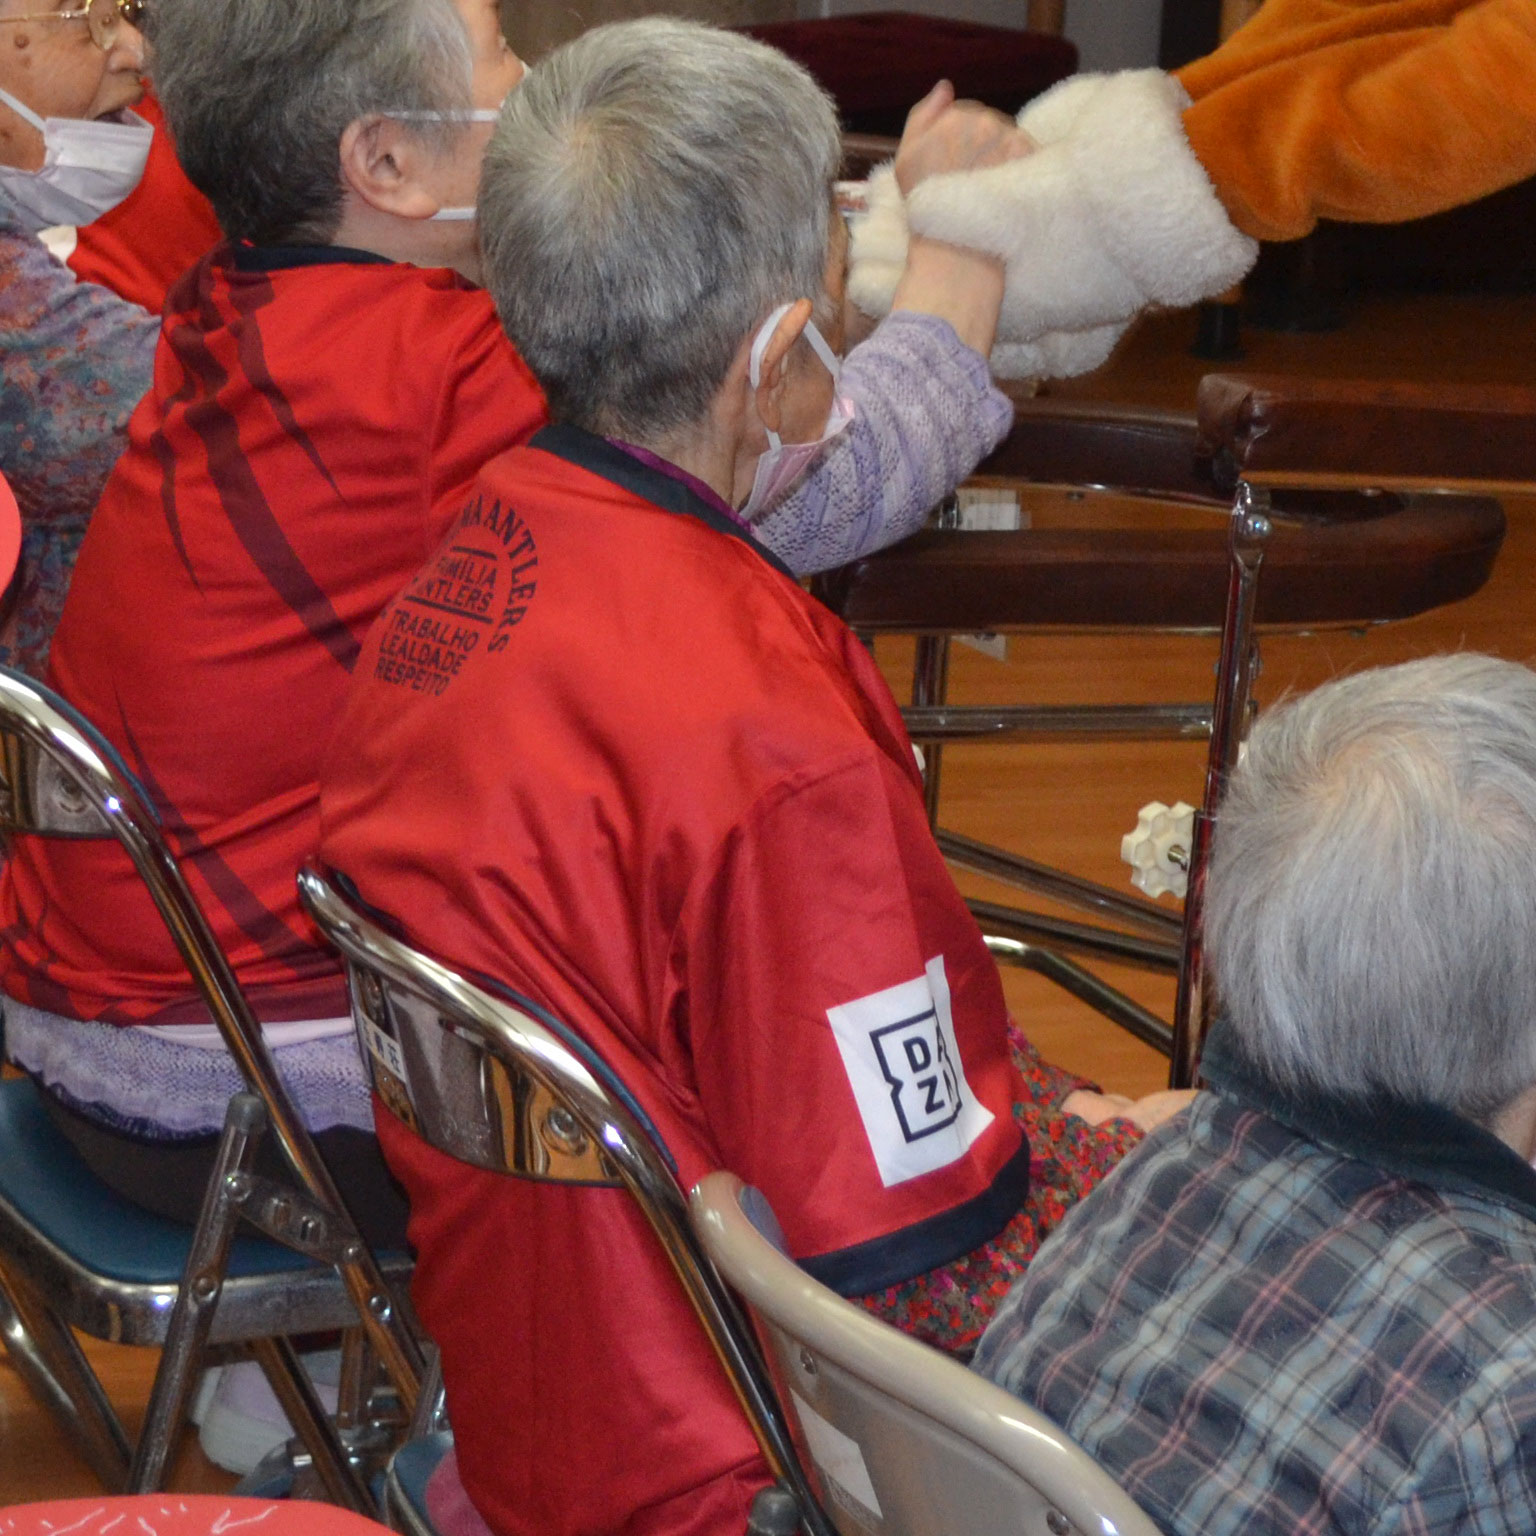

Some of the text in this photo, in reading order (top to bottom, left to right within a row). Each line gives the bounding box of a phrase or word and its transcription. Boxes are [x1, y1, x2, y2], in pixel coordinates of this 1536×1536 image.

[416, 577, 494, 613] NTLERS
[392, 609, 480, 653] TRABALHO
[379, 632, 468, 676] LEALDADE
[374, 657, 451, 697] RESPEITO
